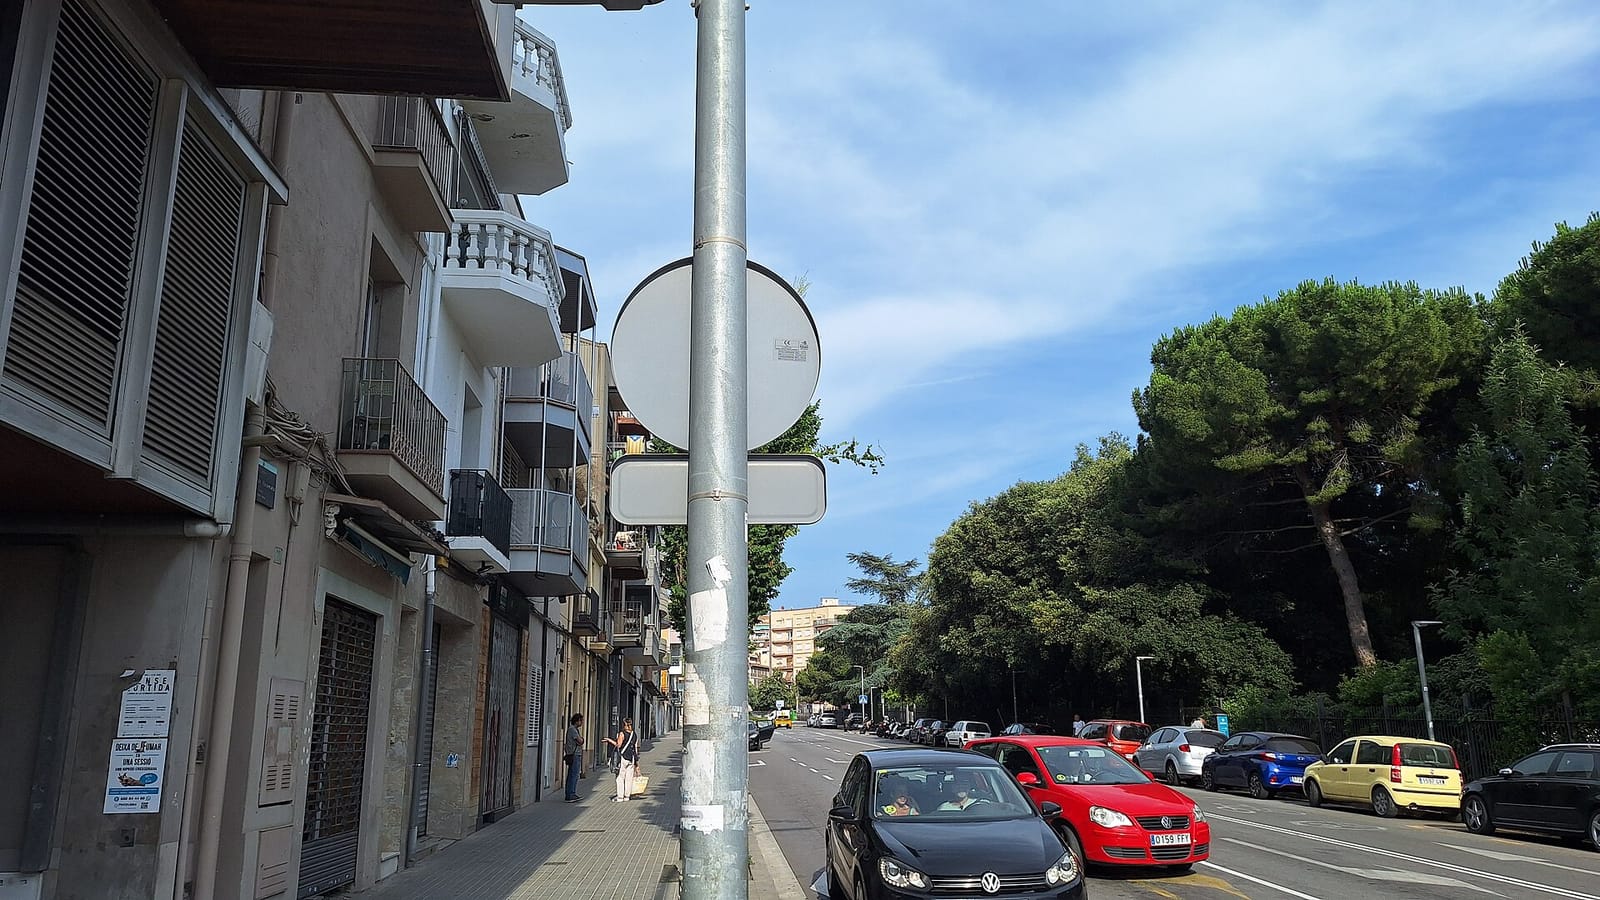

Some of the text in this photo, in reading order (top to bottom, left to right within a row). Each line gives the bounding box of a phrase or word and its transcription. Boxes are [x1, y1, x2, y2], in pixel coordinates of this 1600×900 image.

[145, 677, 168, 685] NSE
[128, 683, 170, 692] ORTIDA
[1155, 834, 1189, 844] 0159 FFY
